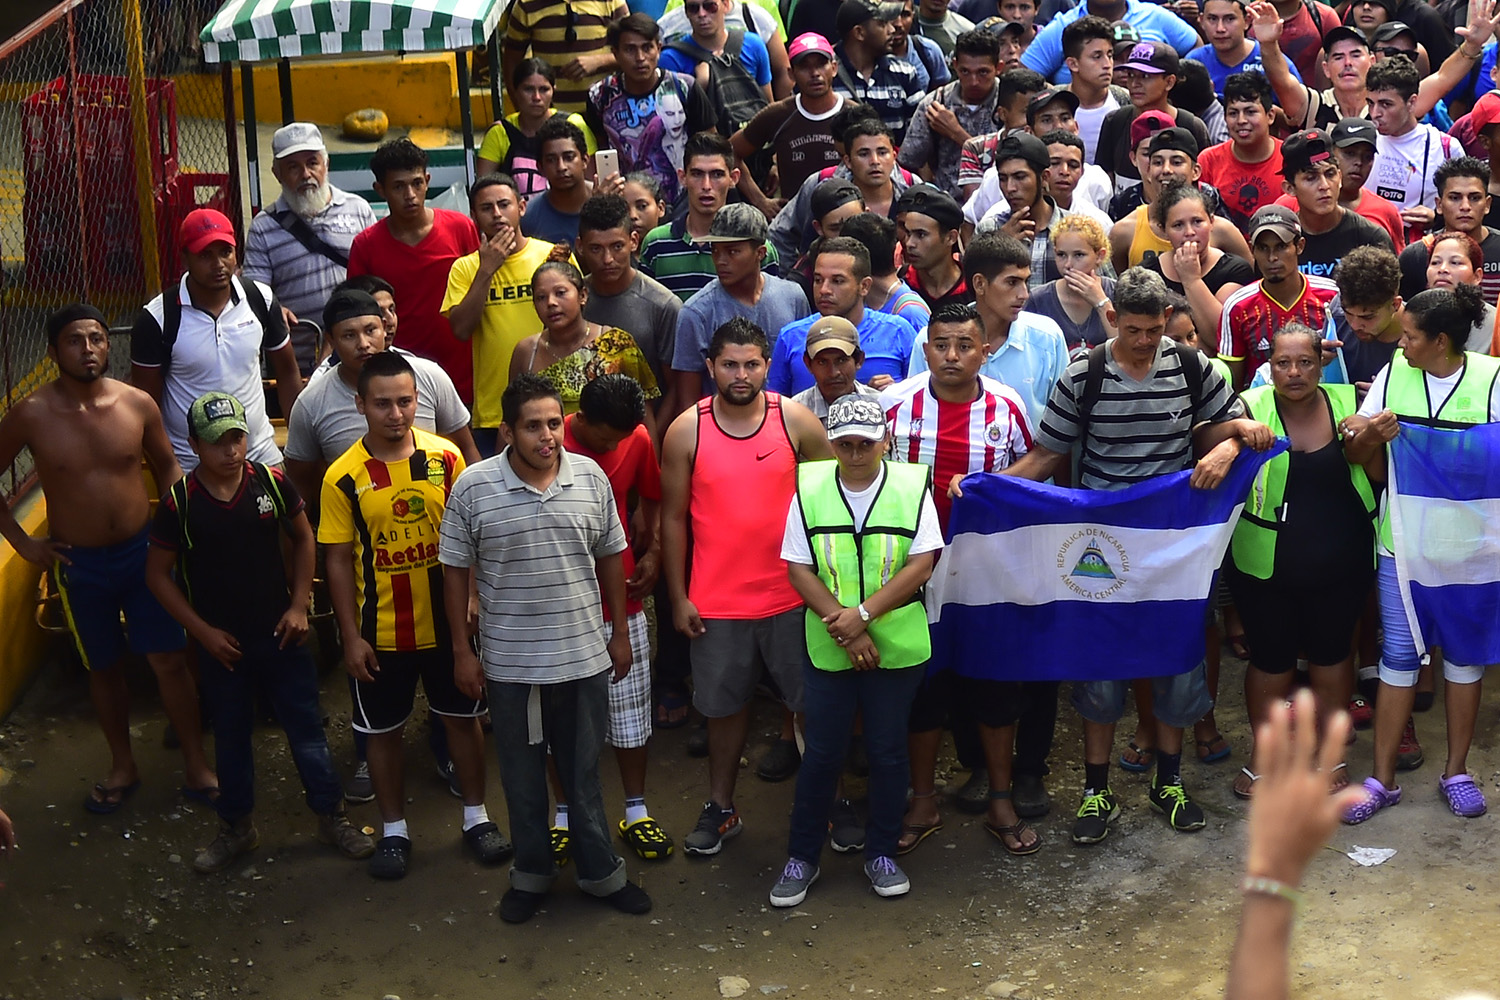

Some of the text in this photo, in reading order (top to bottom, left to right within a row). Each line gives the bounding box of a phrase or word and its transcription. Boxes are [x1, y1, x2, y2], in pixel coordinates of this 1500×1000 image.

[828, 400, 883, 429] BOSS
[1057, 528, 1130, 573] REPUBLICA DE NICARAGUA
[1061, 574, 1127, 600] AMERICA CENTRAL
